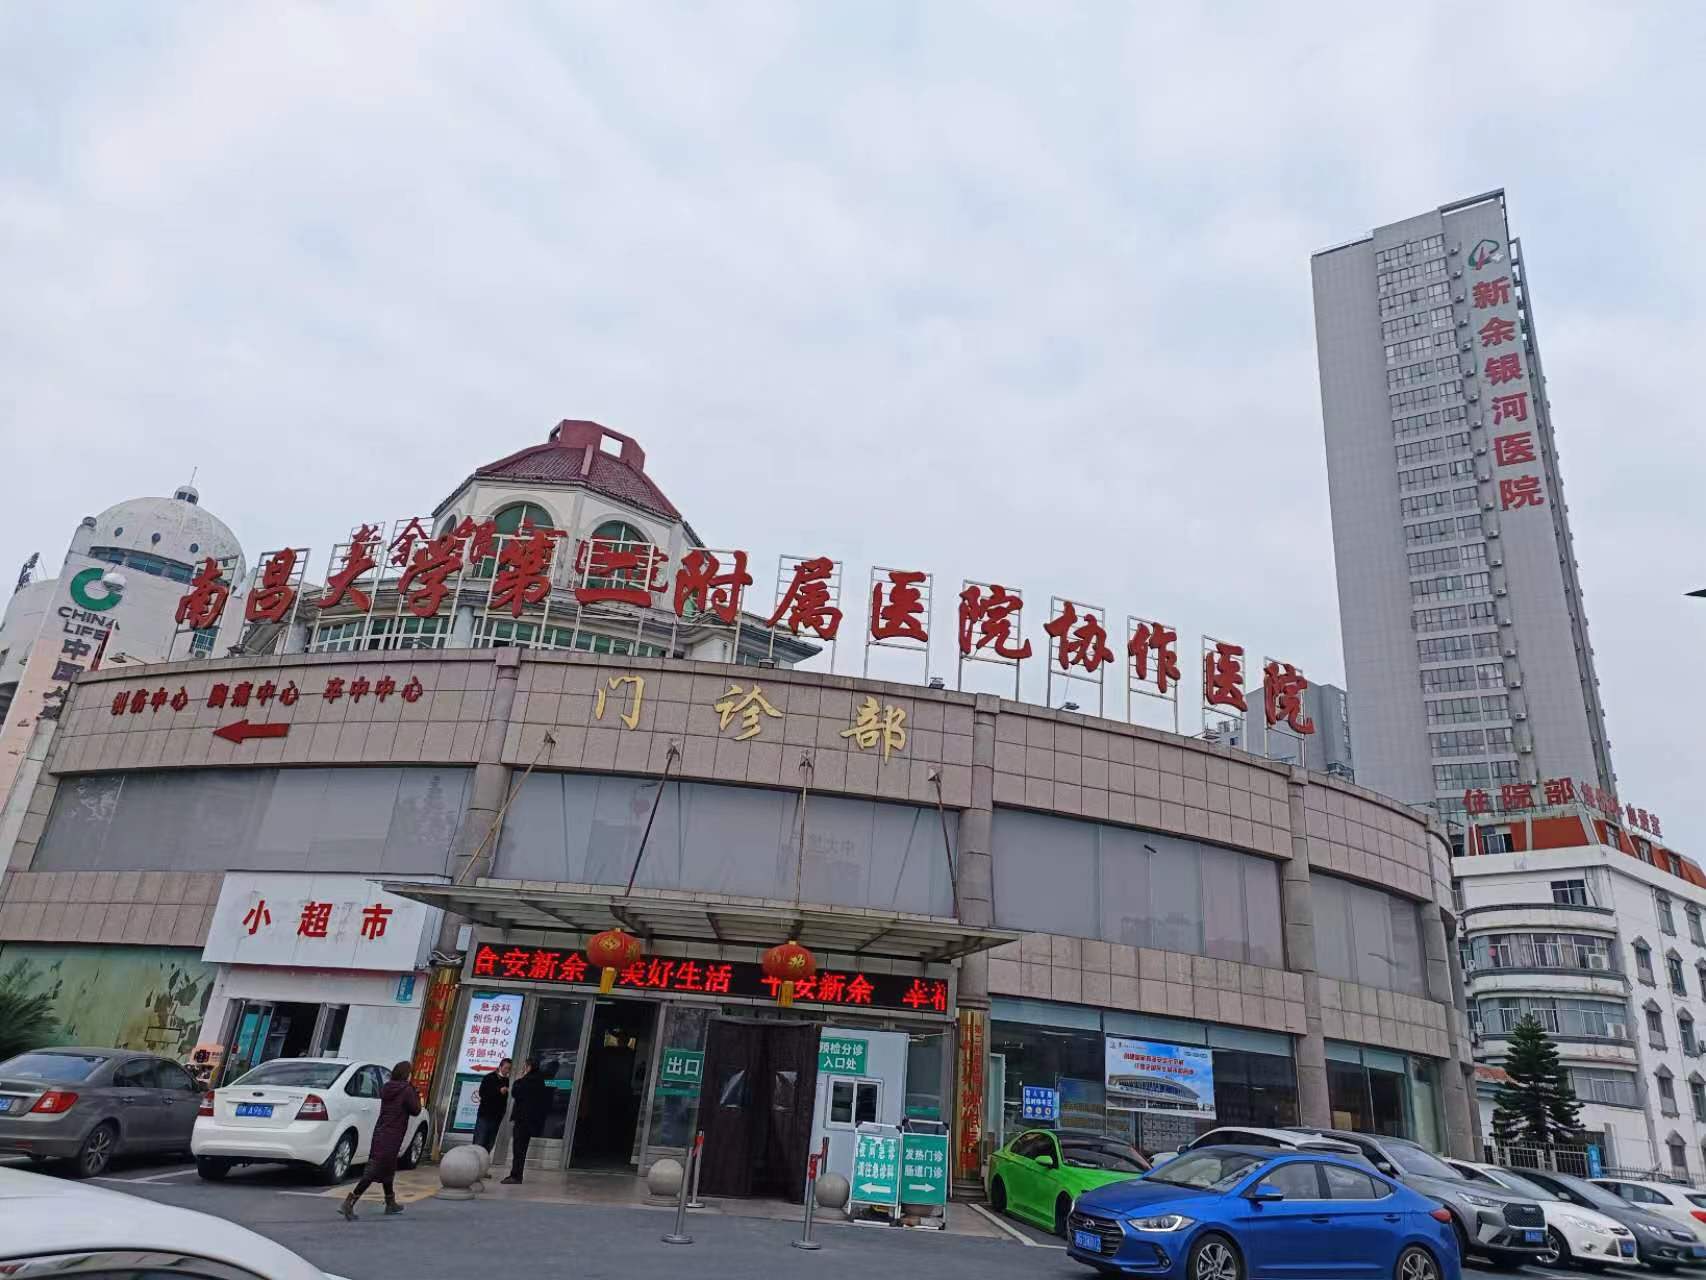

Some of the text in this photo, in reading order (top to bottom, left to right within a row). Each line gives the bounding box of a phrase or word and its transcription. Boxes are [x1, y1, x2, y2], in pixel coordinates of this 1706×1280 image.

[1472, 276, 1544, 511] 新余银河医院
[58, 606, 120, 630] CHINA
[63, 621, 107, 641] LIFE
[323, 676, 423, 703] 卒中中心
[595, 675, 907, 766] 门诊部
[1463, 777, 1574, 814] 住院部
[243, 900, 393, 940] 小超市
[667, 1056, 700, 1076] 出口
[823, 1055, 858, 1071] 入口处
[905, 1148, 944, 1163] 发热门诊
